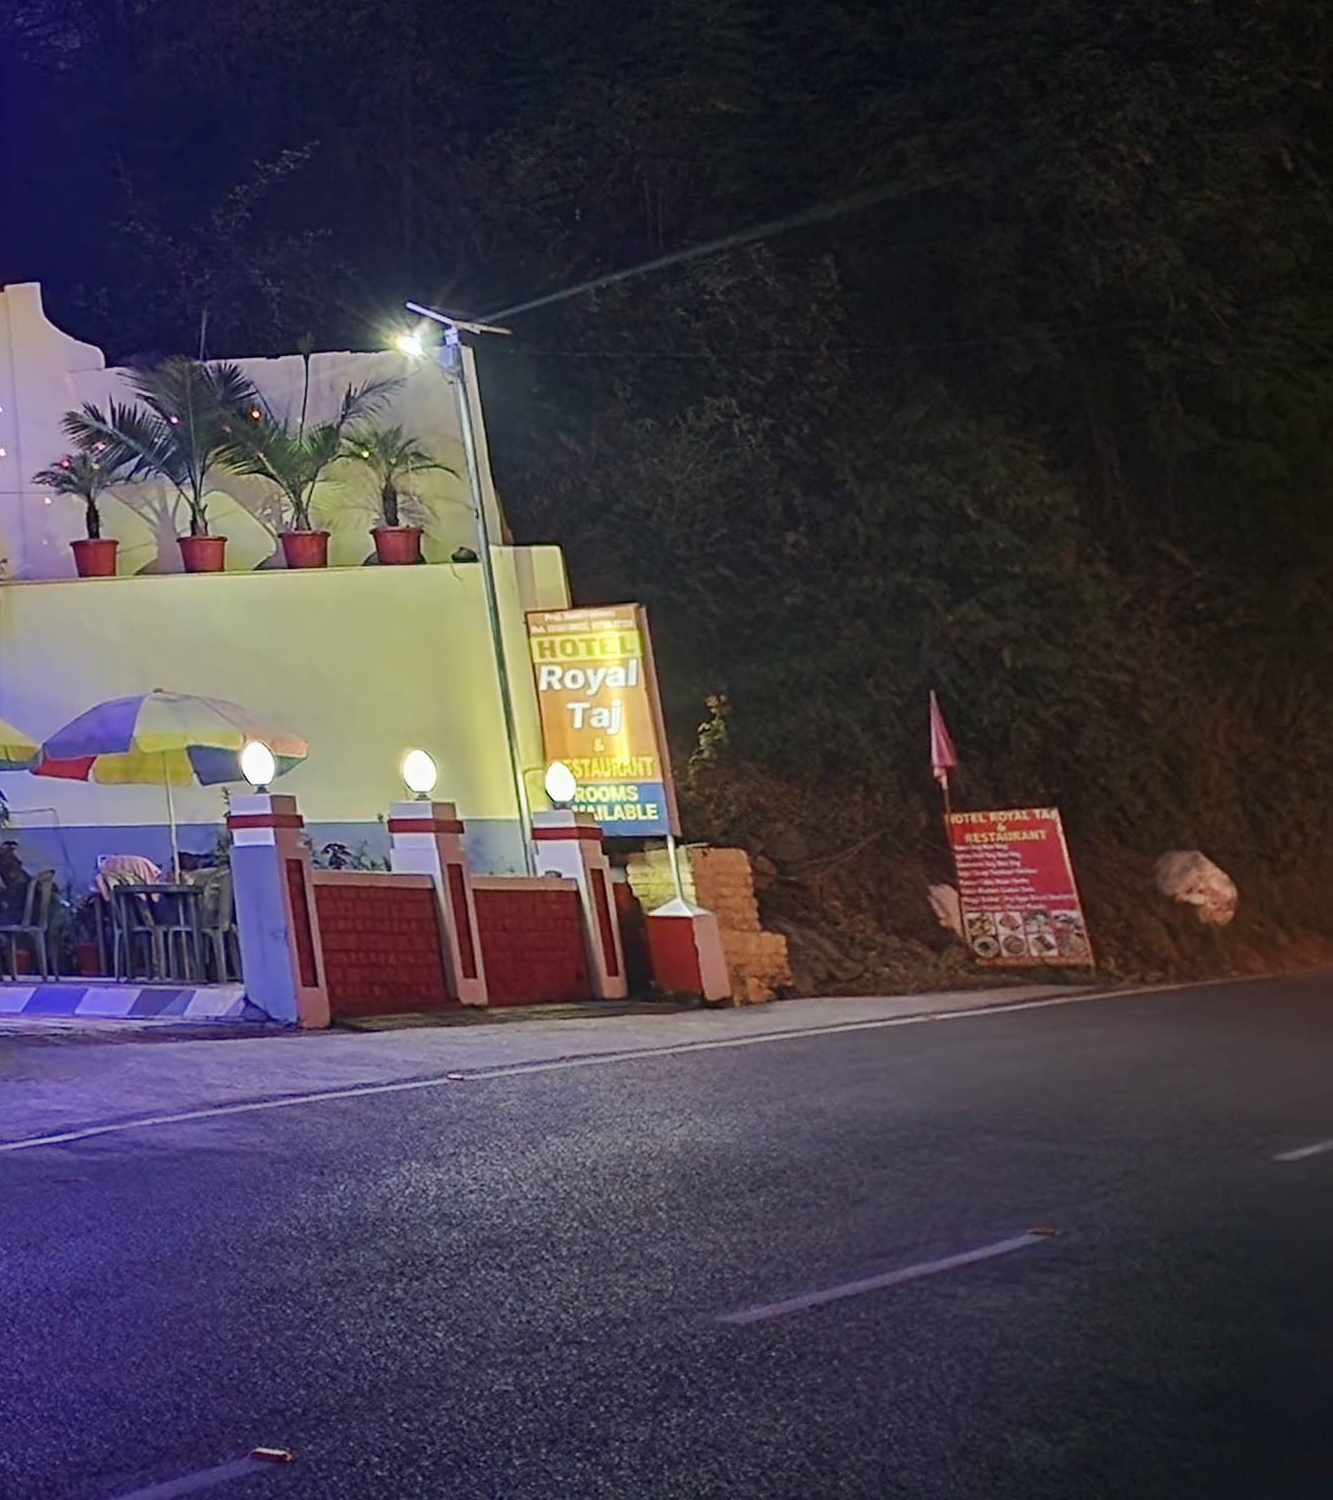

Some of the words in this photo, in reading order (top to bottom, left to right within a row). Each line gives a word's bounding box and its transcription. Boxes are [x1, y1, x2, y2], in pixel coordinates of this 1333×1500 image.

[537, 635, 636, 659] HOTEL
[539, 658, 638, 696] Royal
[566, 698, 622, 735] Taj
[594, 739, 605, 751] &
[563, 756, 655, 779] STAURANT
[574, 785, 639, 803] ROOMS
[989, 809, 1032, 822] ROYAL
[965, 829, 1047, 843] RESTAURANT
[997, 822, 1007, 832] &
